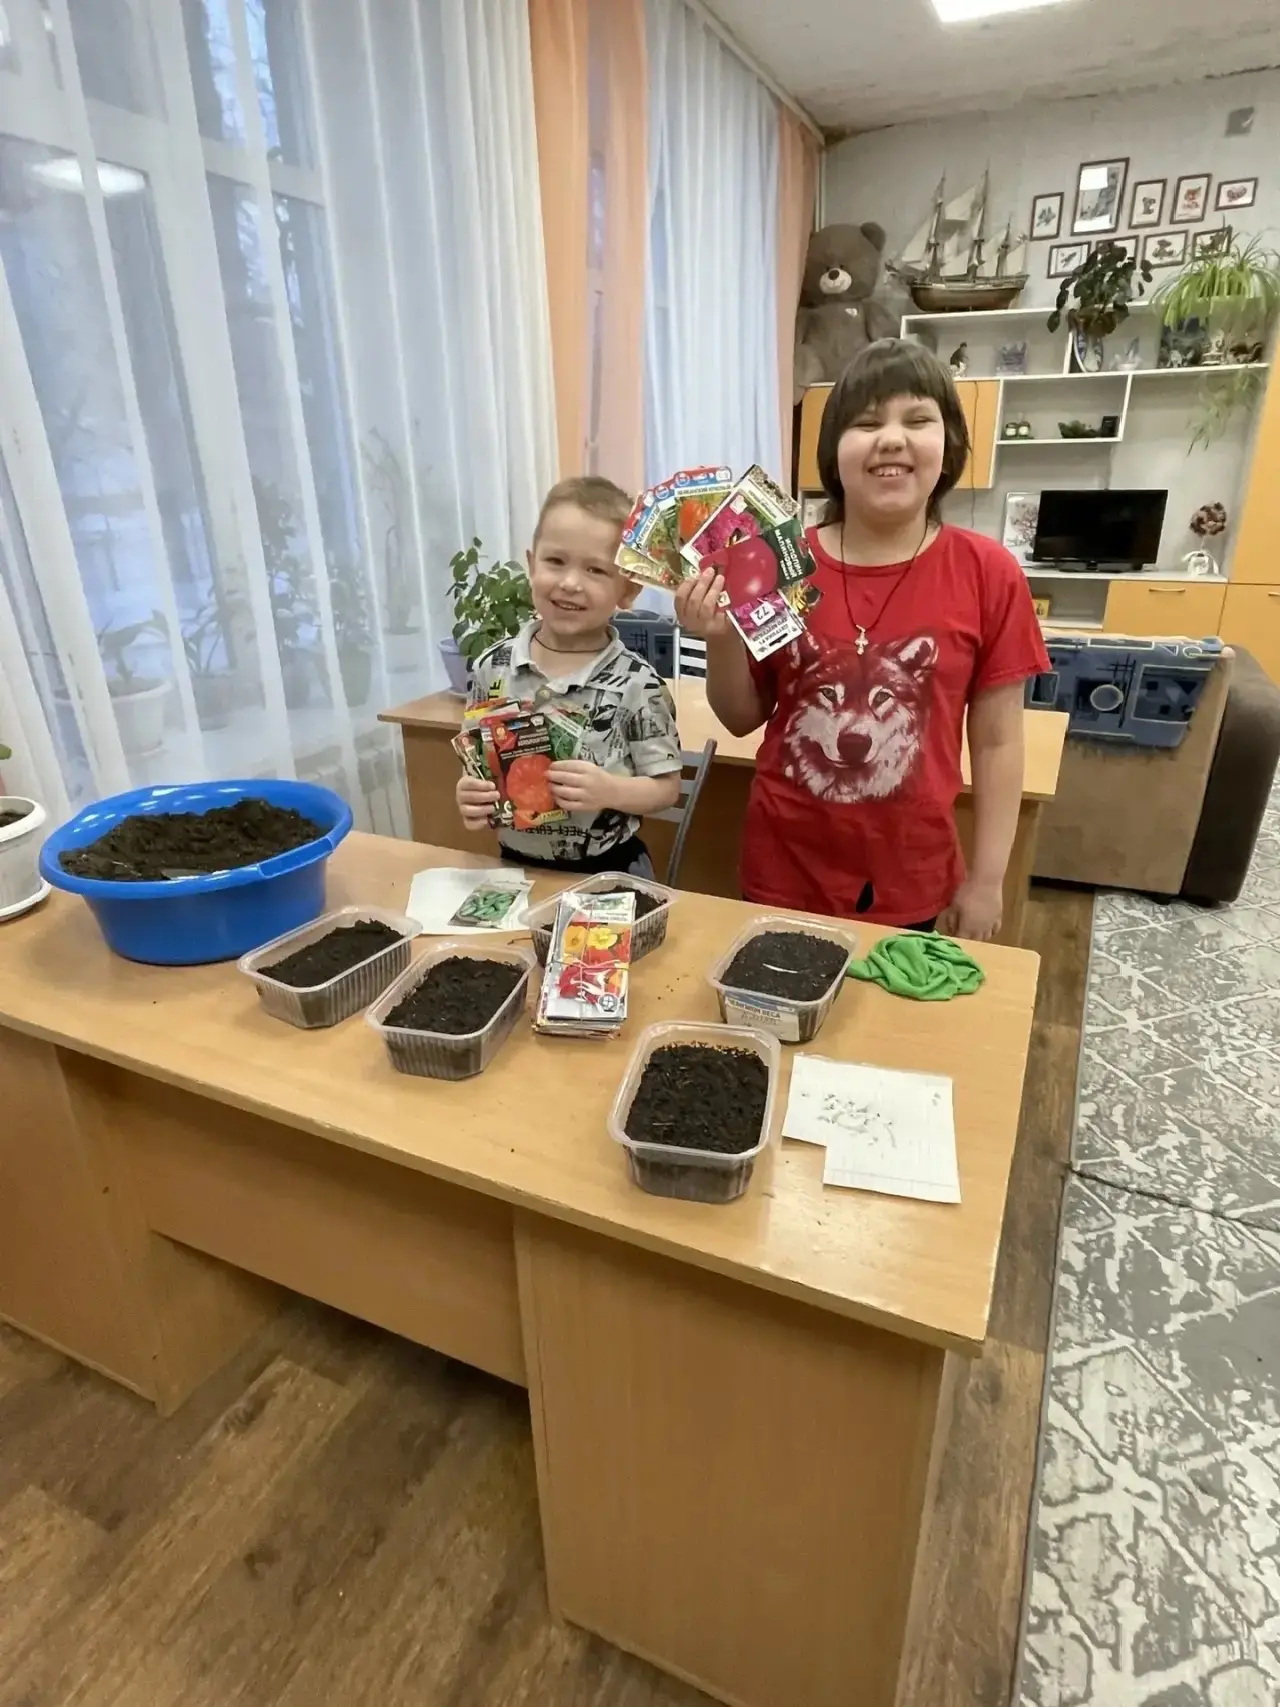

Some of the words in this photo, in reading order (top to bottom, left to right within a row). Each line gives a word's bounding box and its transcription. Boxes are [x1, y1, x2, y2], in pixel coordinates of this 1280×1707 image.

[775, 529, 796, 578] МАЛИНОВЫЙ
[786, 538, 803, 575] ИСПОЛИН
[756, 604, 770, 620] 72
